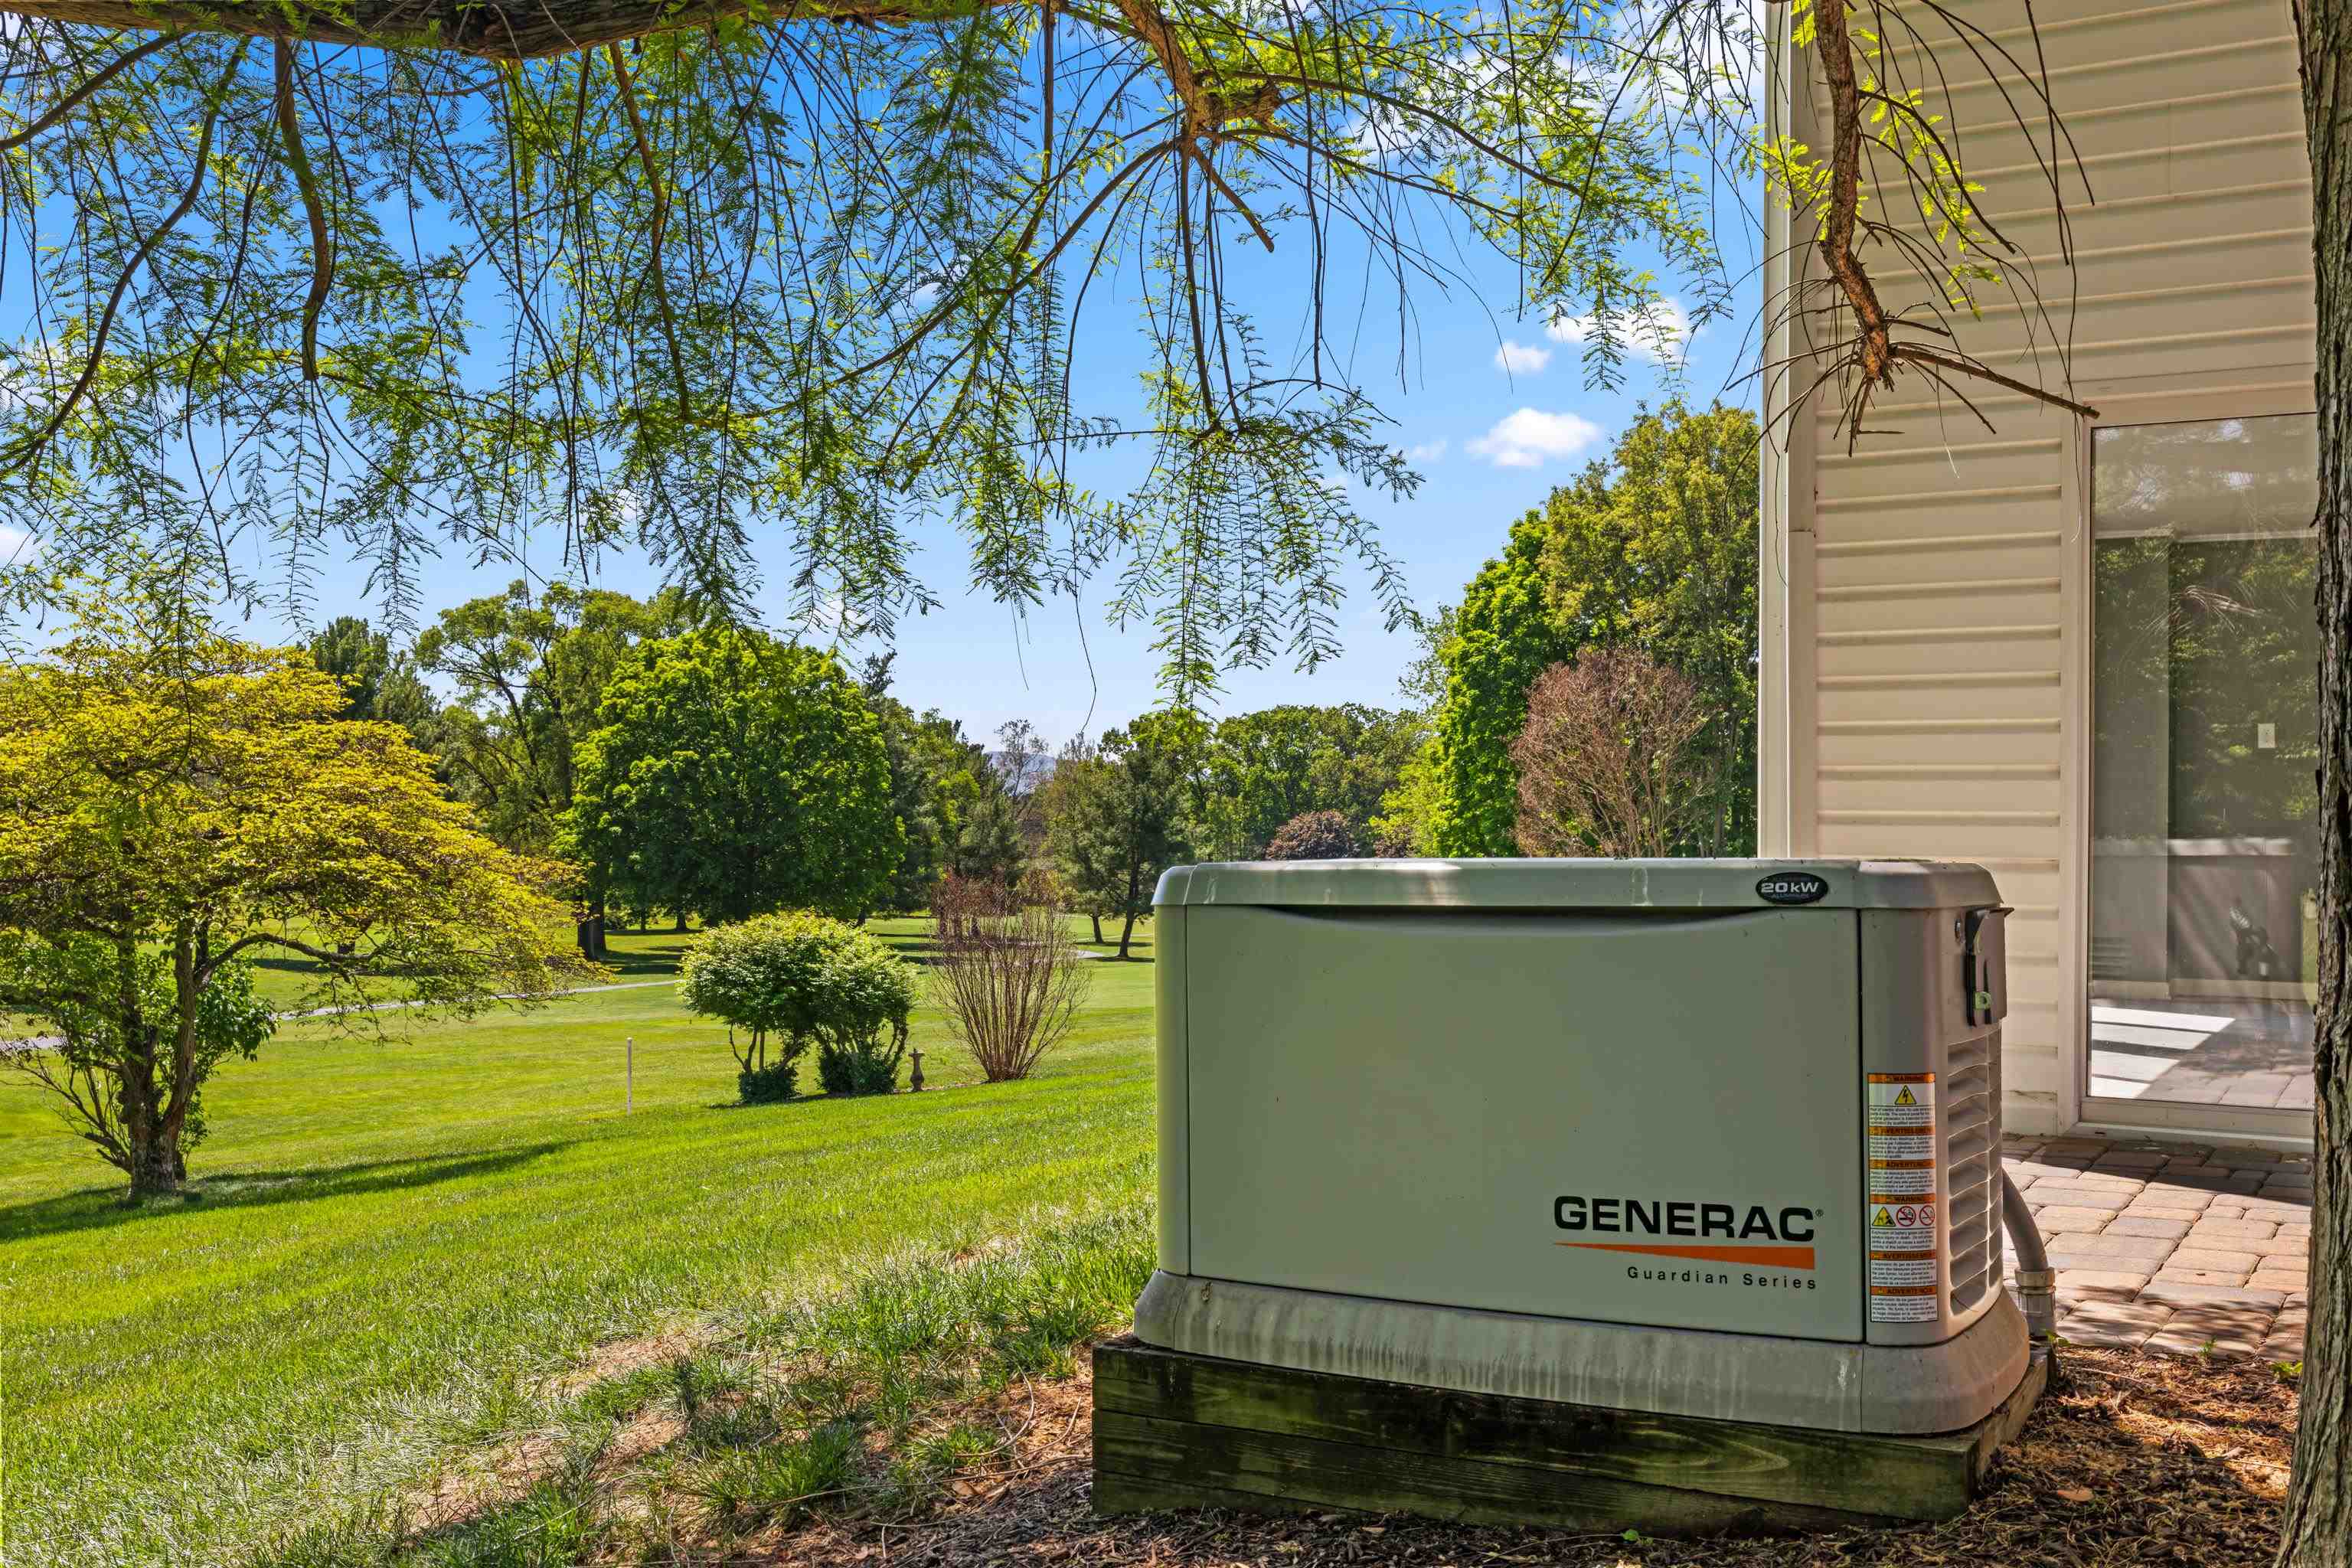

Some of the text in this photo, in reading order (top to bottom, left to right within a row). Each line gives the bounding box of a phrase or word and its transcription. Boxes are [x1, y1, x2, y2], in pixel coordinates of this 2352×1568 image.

[1553, 1195, 1815, 1242] GENERAC
[1627, 1266, 1816, 1289] Guardian Series
